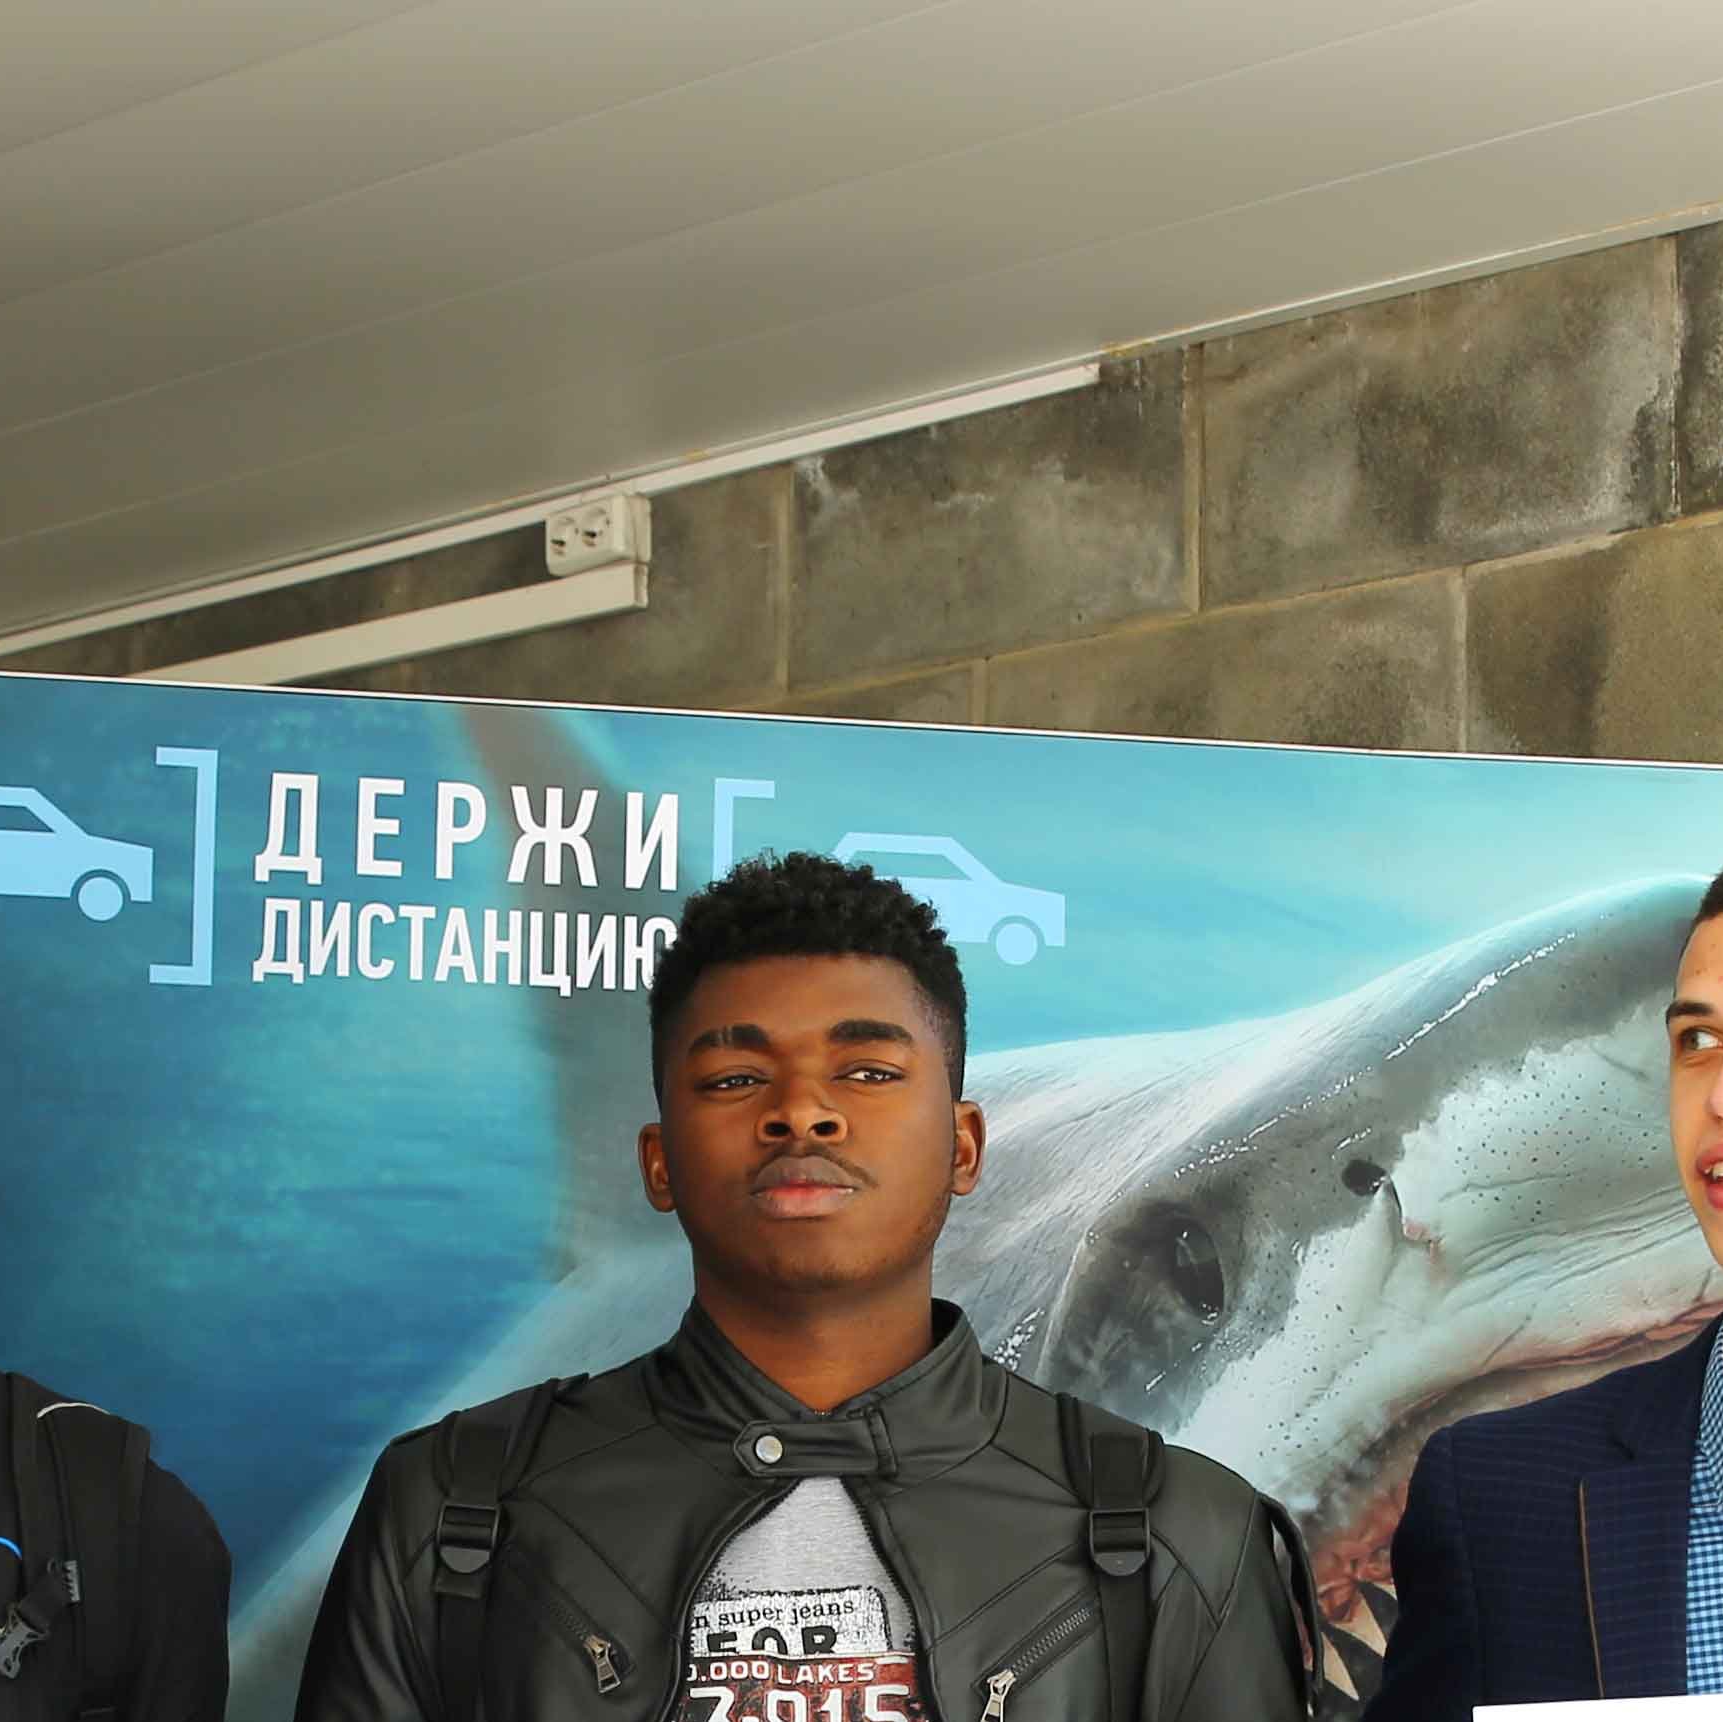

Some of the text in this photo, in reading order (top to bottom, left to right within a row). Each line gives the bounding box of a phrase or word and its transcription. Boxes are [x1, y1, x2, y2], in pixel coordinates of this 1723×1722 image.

[255, 773, 678, 891] ДЕРЖИ
[251, 897, 678, 997] ДИСТАНЦИЮ
[718, 1606, 785, 1627] super
[789, 1599, 855, 1625] jeans
[777, 1662, 876, 1684] LAKES
